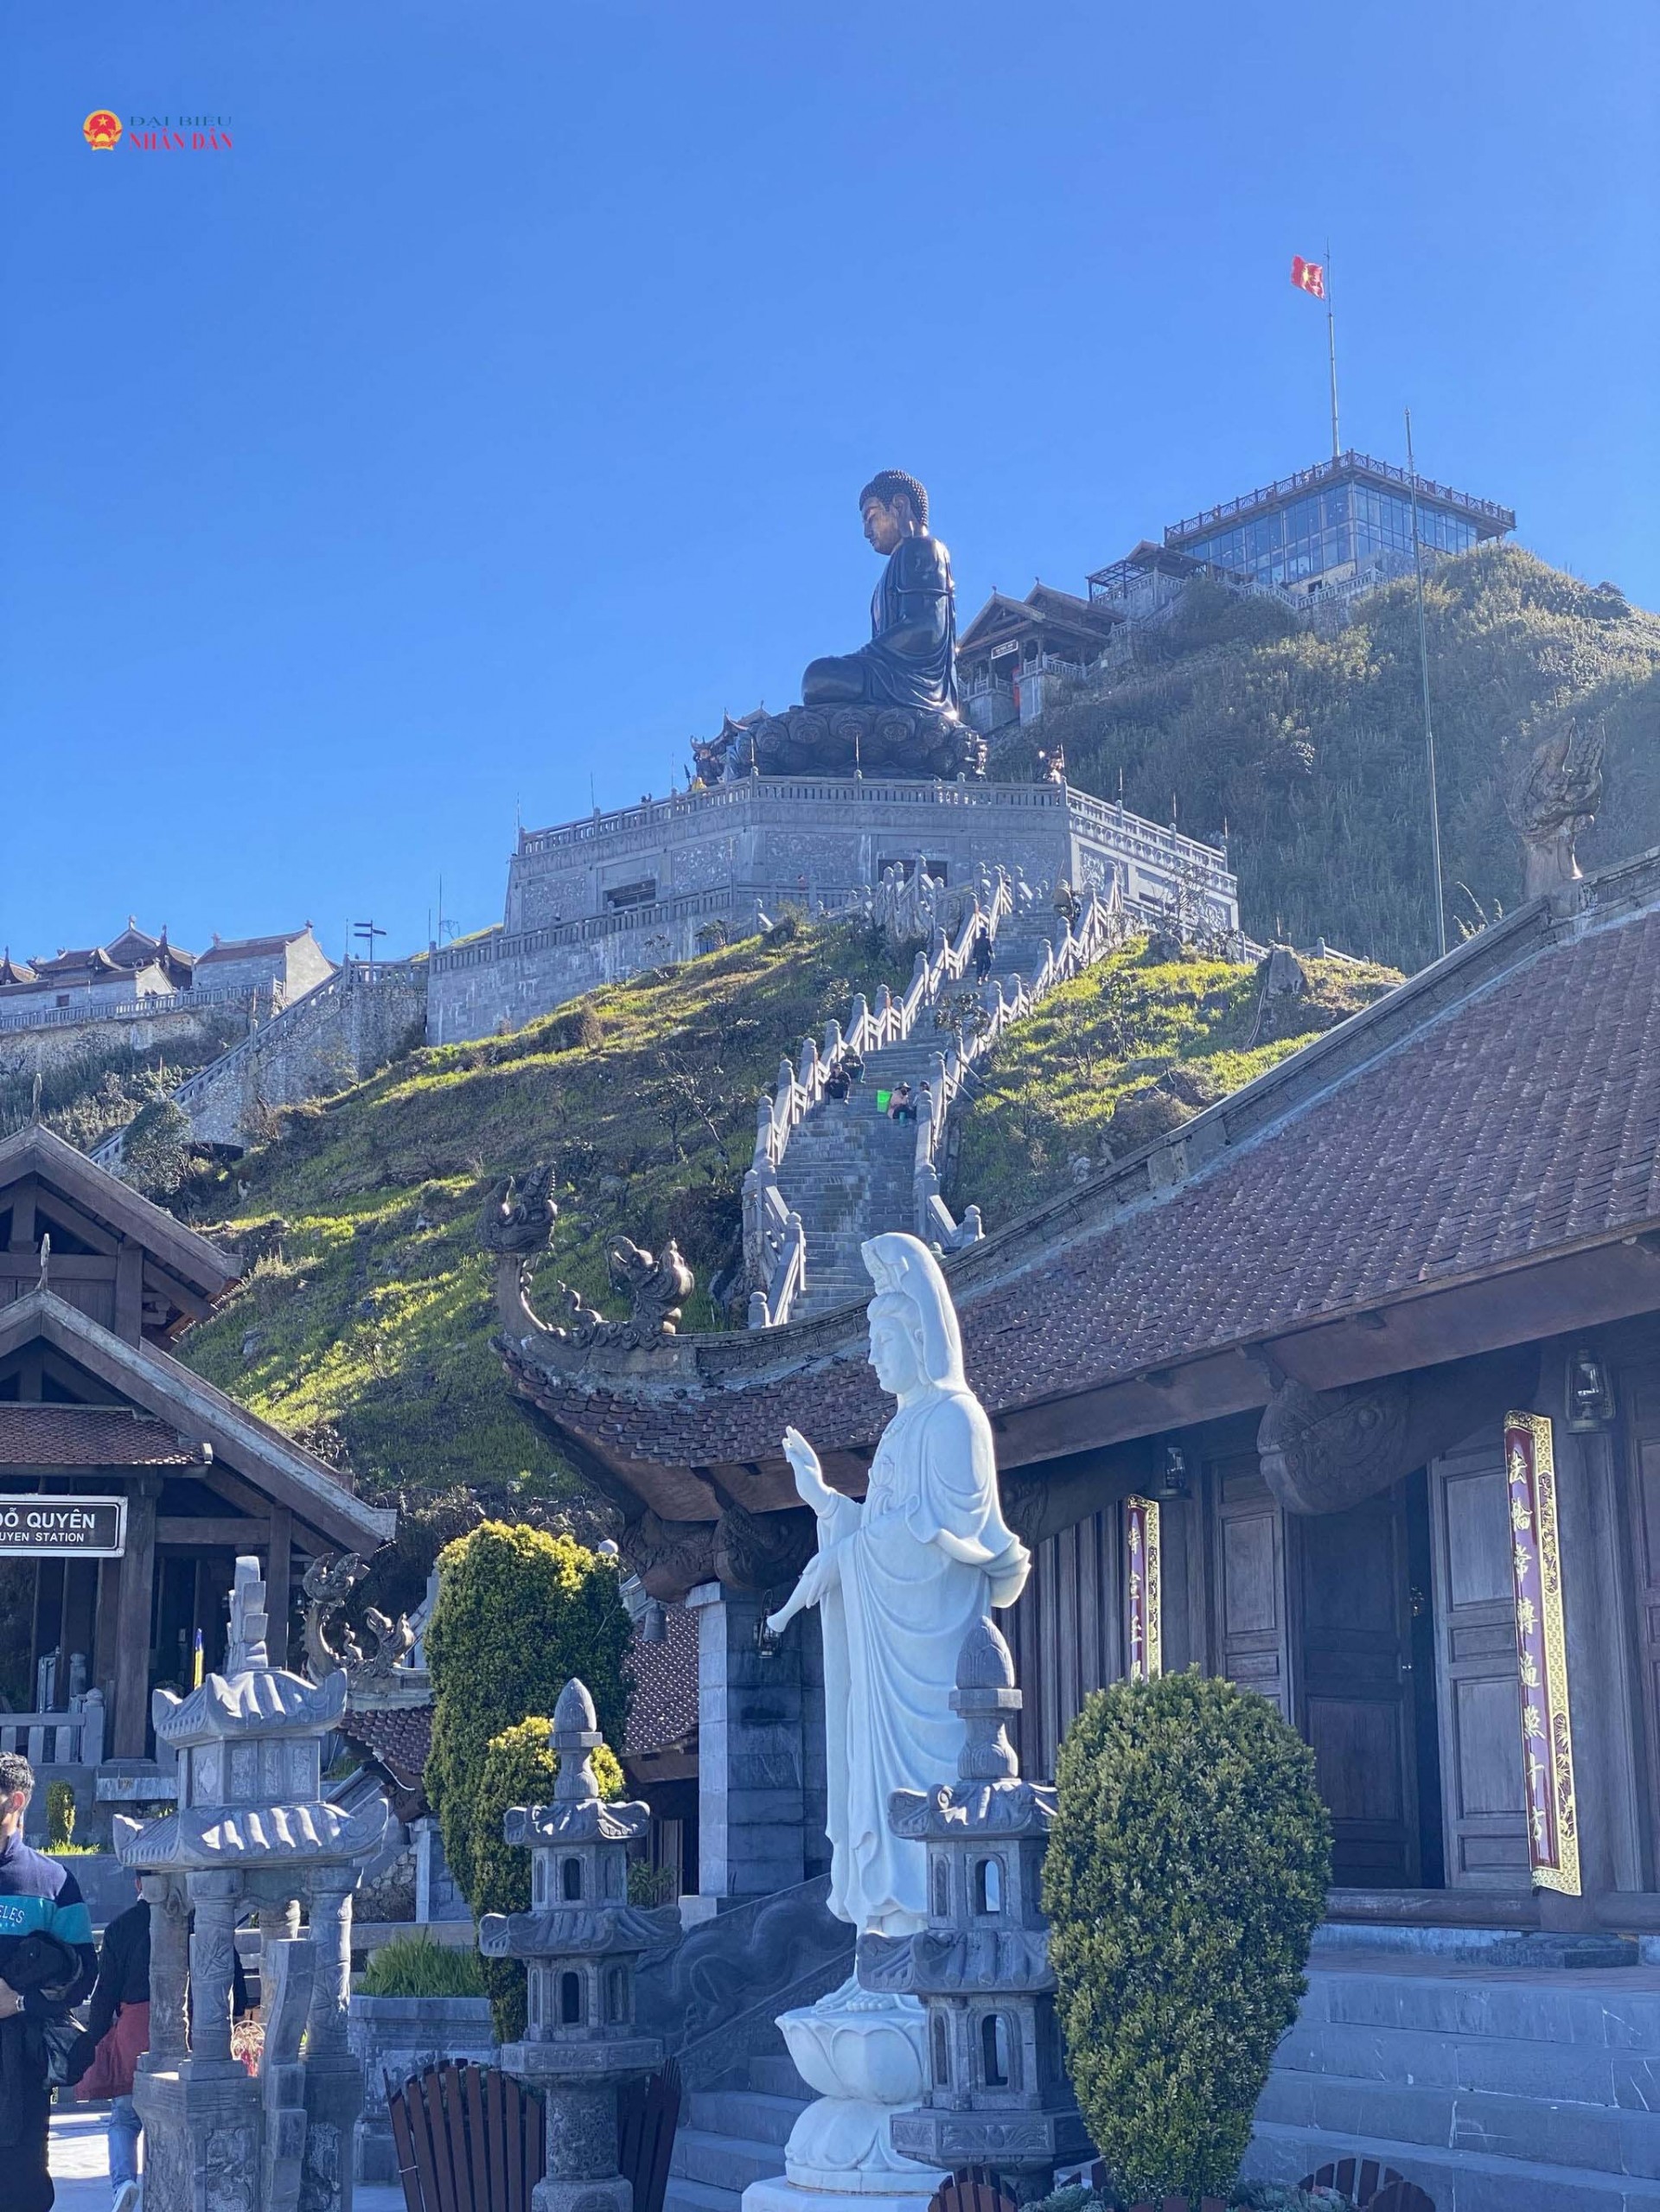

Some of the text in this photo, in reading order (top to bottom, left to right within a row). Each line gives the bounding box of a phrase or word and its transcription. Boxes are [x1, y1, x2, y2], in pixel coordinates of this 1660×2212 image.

[0, 1507, 95, 1529] Ỗ QUYÊN
[35, 1532, 85, 1543] STATION
